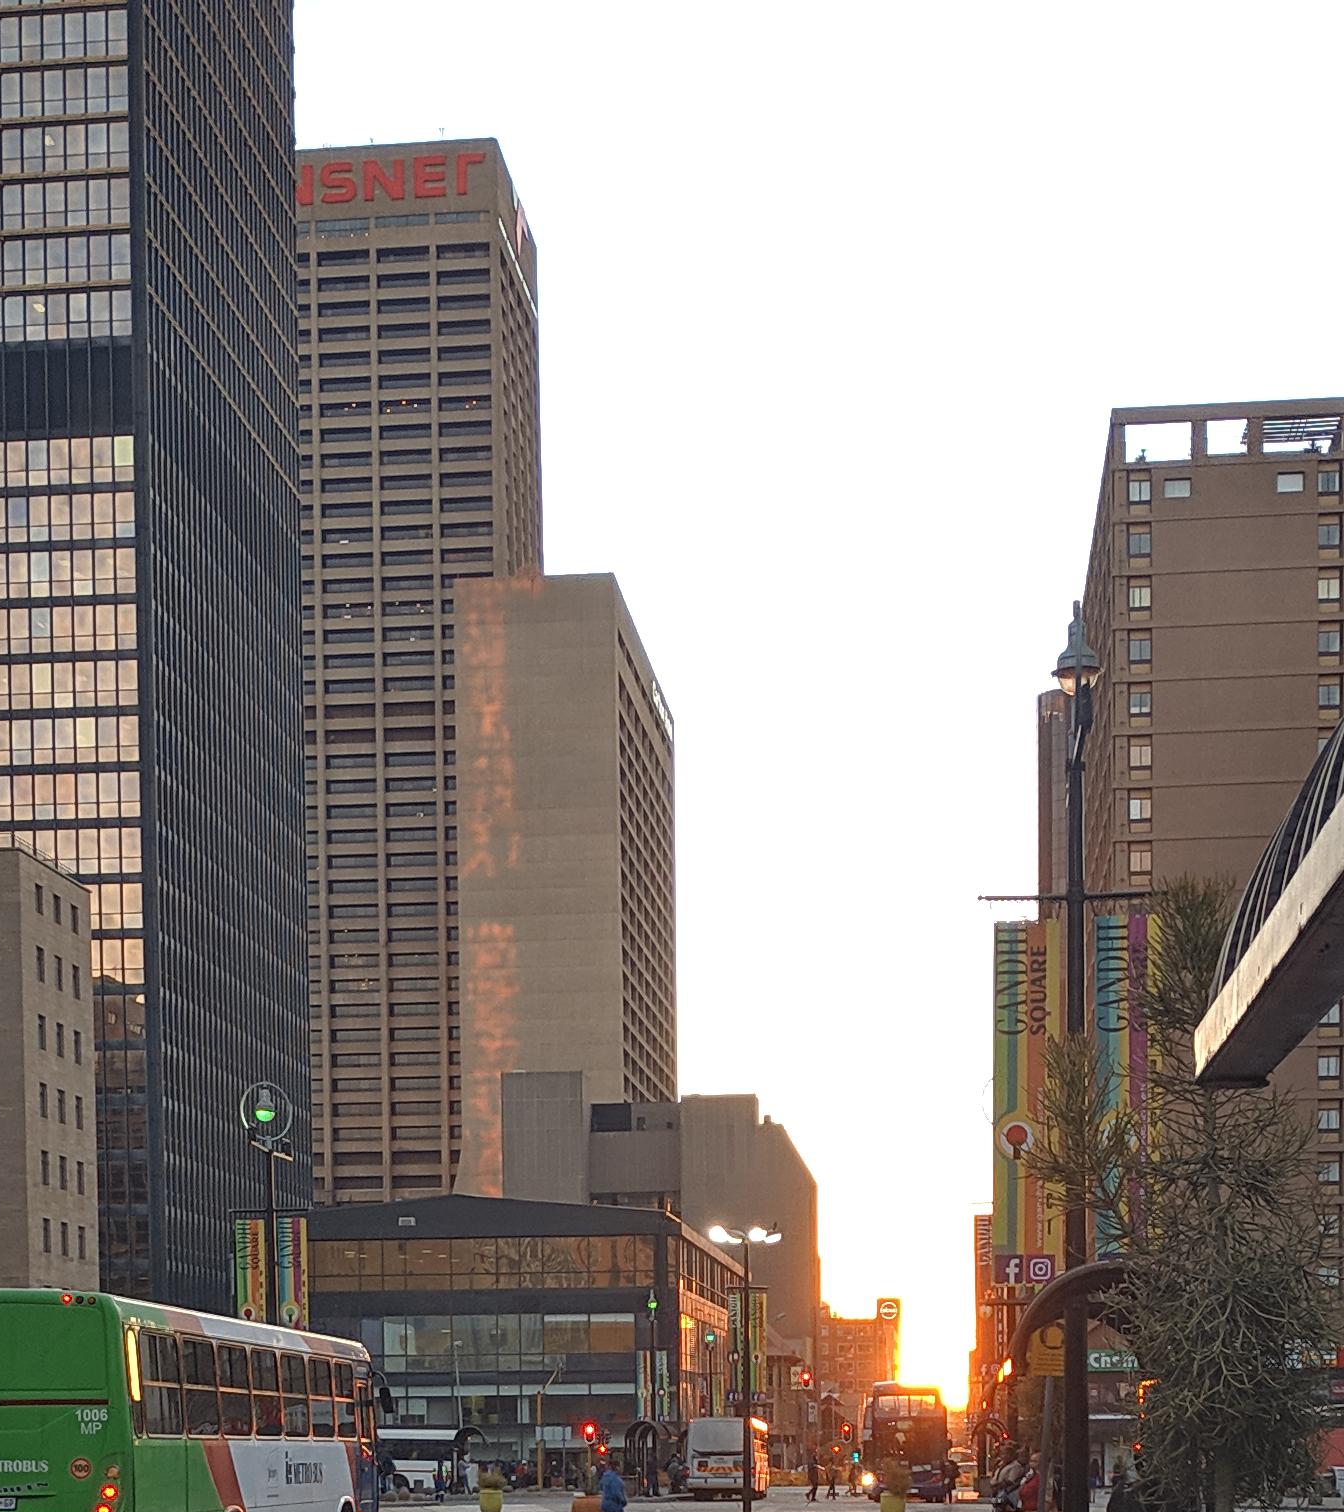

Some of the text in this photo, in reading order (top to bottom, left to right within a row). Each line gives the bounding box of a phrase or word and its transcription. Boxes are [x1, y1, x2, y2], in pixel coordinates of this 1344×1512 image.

[997, 928, 1028, 1035] GANDHI
[1030, 945, 1050, 1035] SQUARE
[1097, 922, 1129, 1033] GANDHI
[75, 1409, 108, 1421] 1006
[81, 1422, 102, 1435] MP
